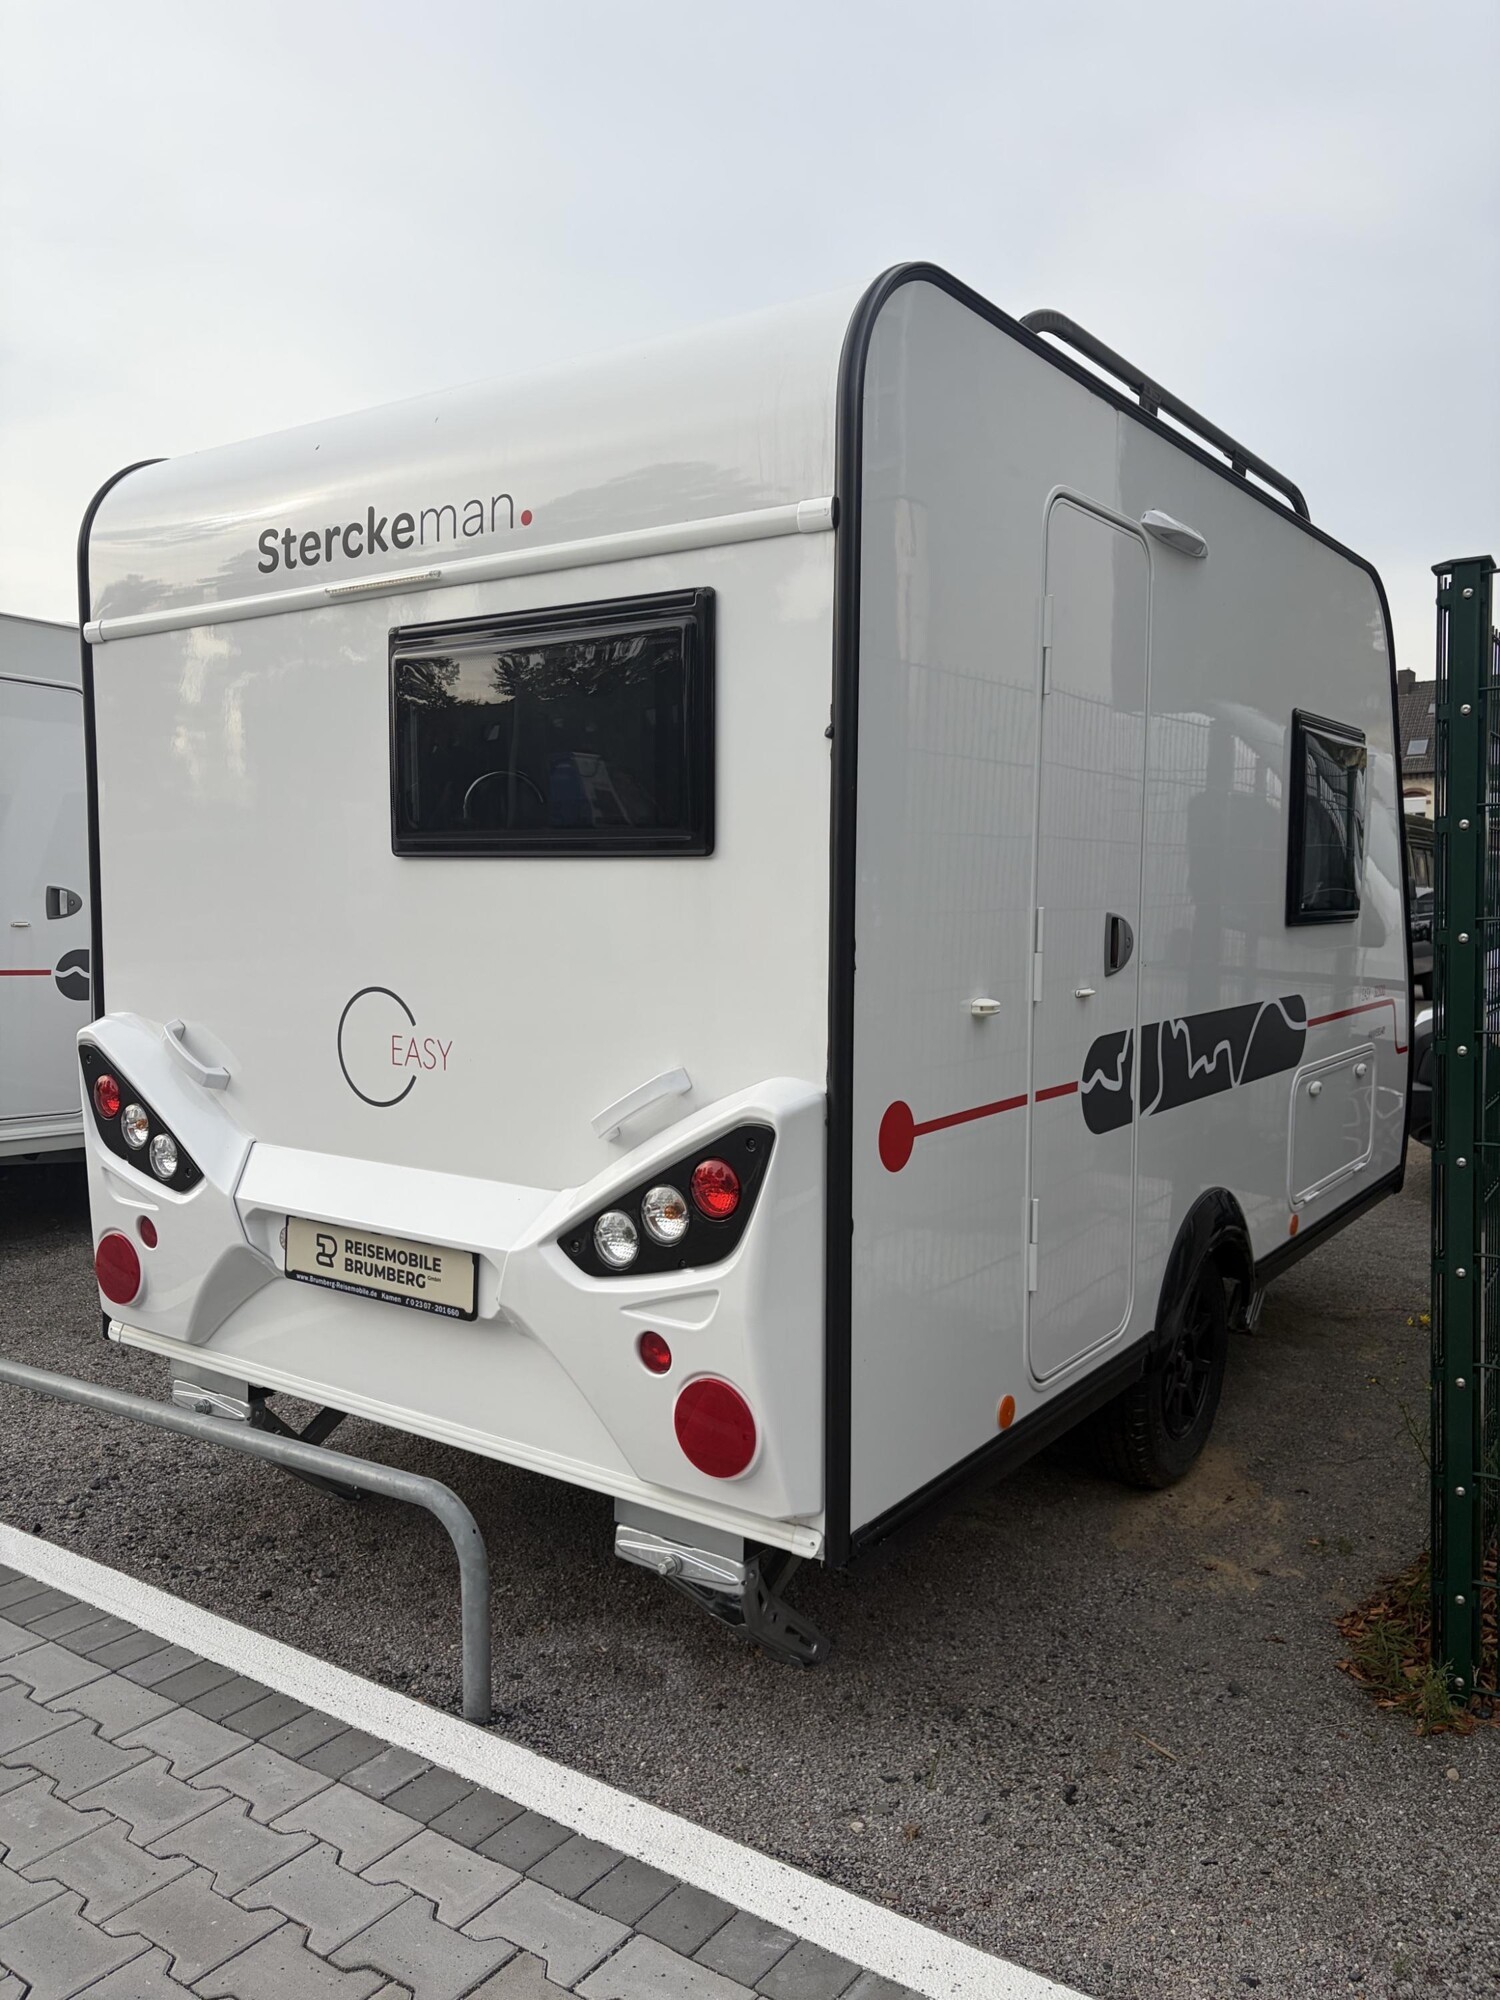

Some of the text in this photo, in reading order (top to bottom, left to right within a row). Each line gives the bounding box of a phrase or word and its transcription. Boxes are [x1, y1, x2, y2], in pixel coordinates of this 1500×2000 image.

[390, 1033, 453, 1071] EASY
[344, 1238, 442, 1273] REISEMOBILE
[296, 1273, 378, 1298] www.Brumberg-Reisemobile.de
[381, 1291, 402, 1304] Kamen
[344, 1257, 427, 1289] BRUMBERG
